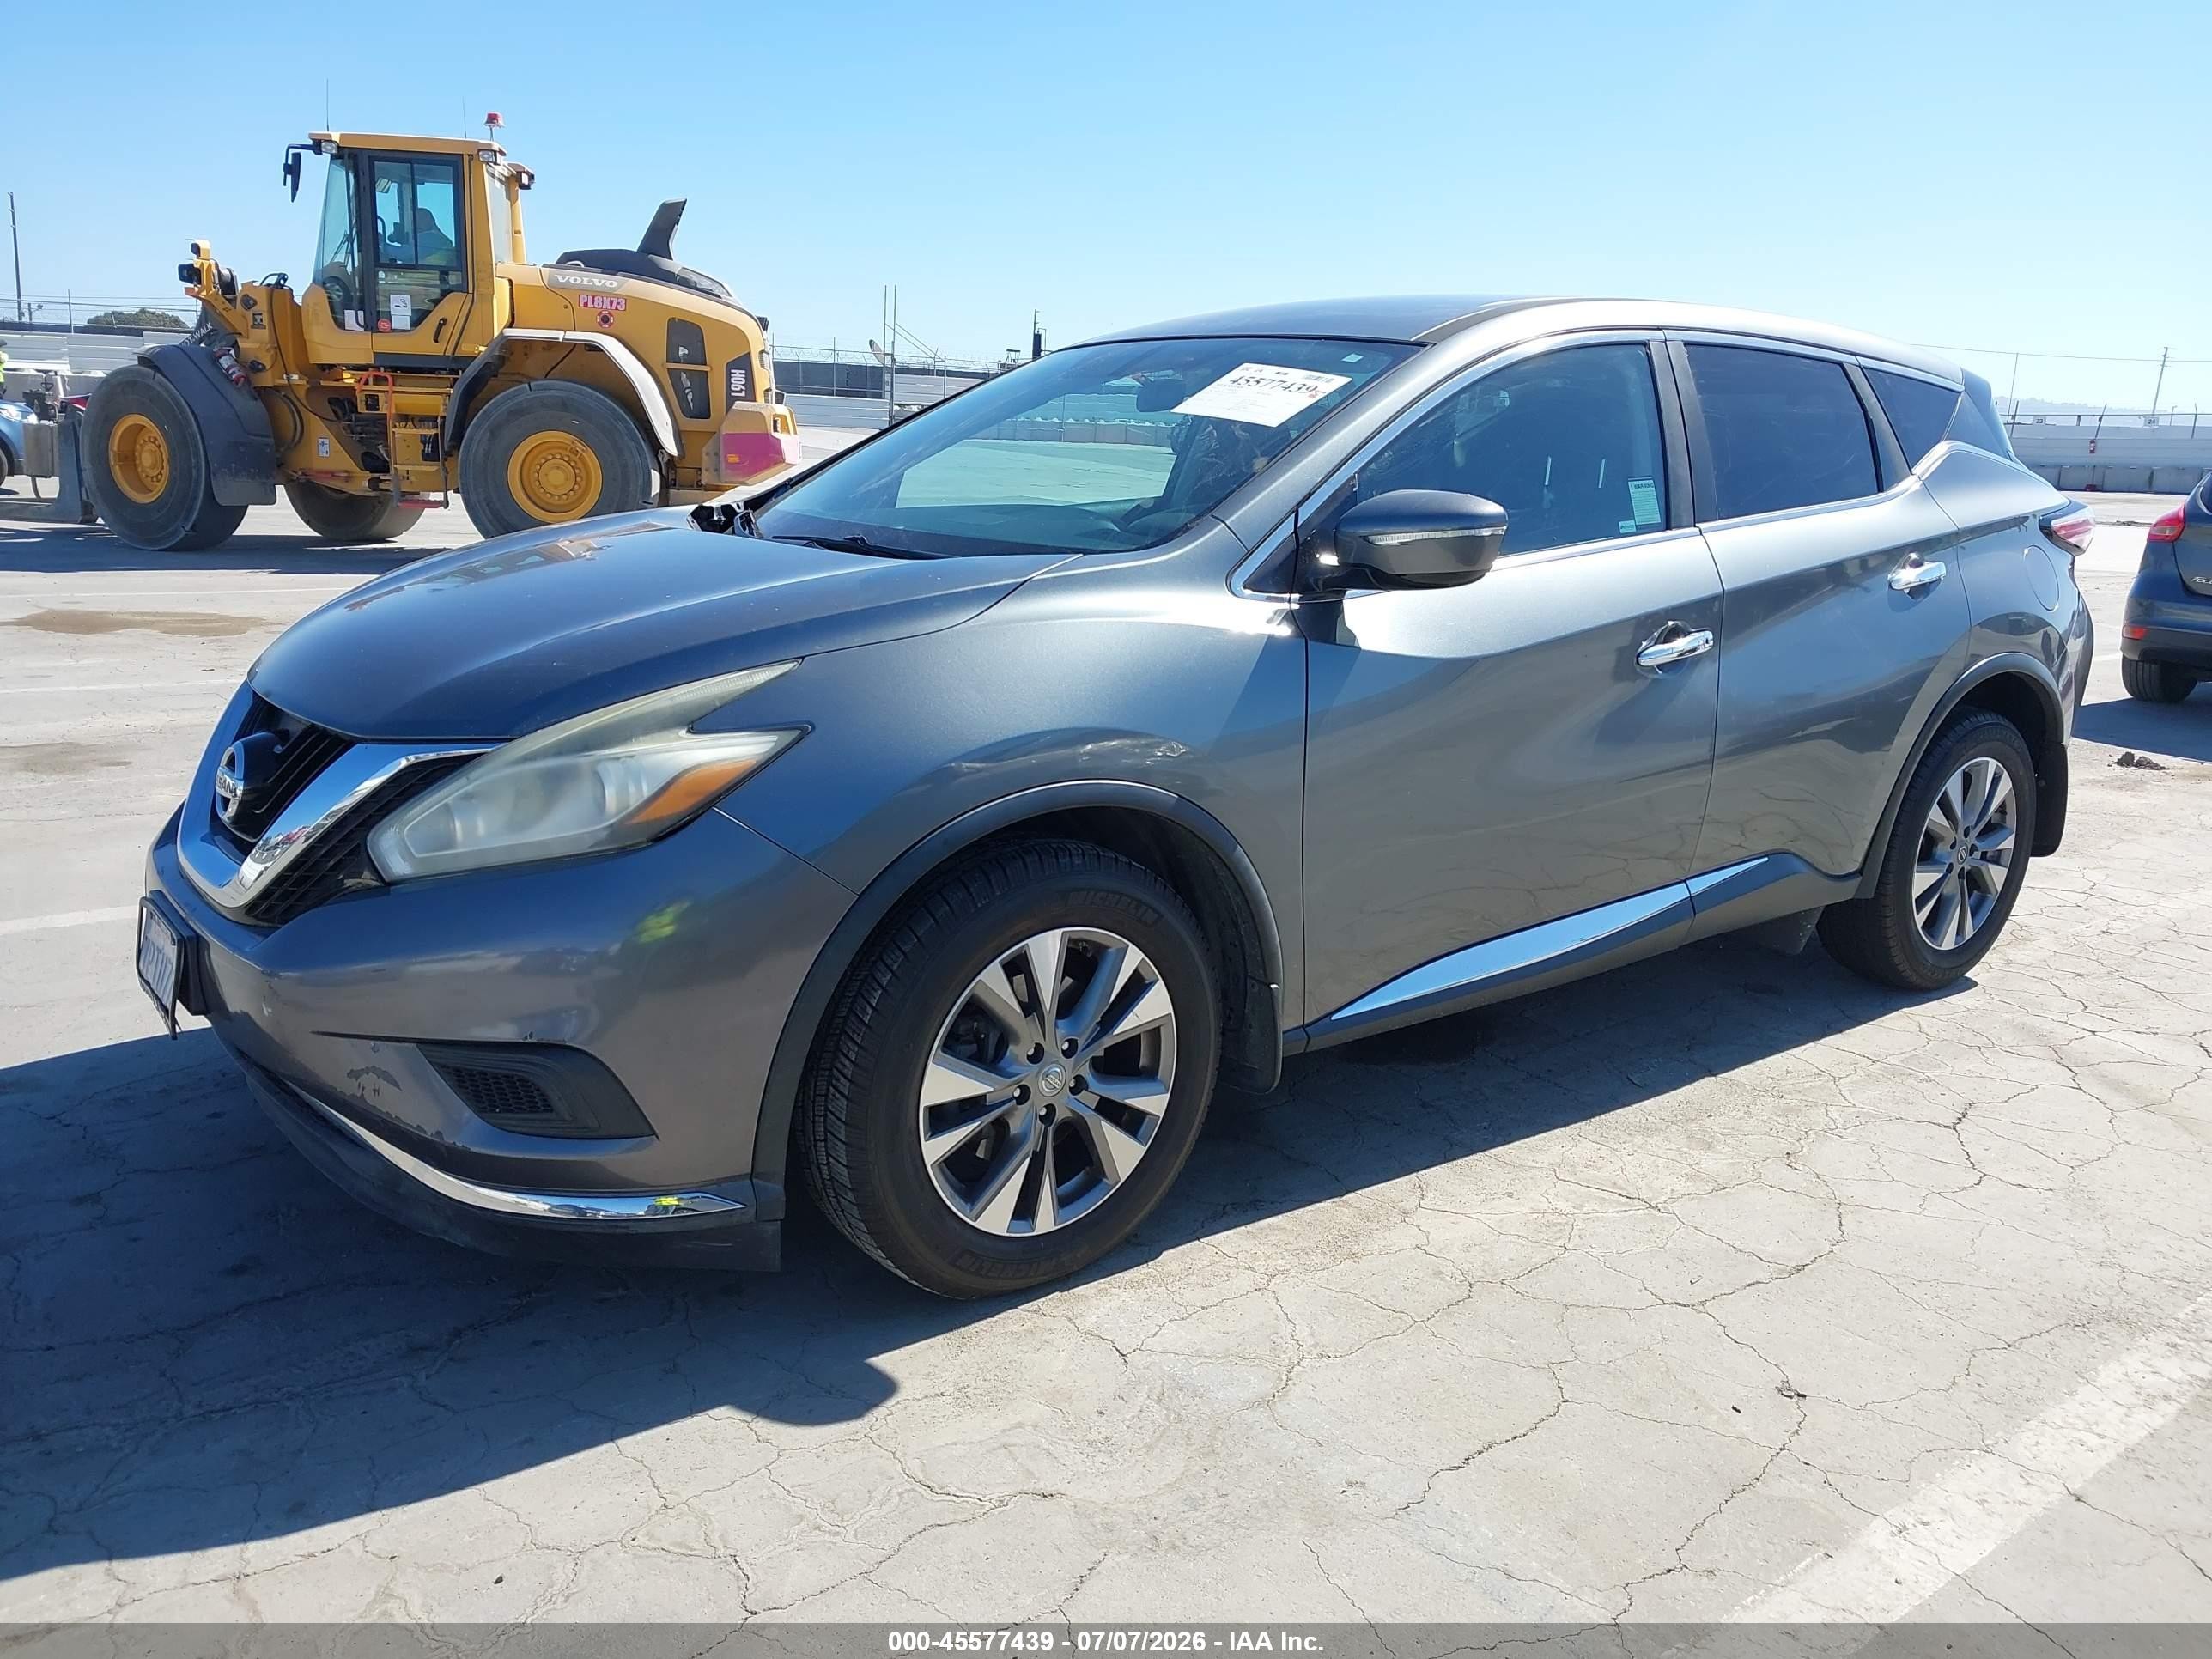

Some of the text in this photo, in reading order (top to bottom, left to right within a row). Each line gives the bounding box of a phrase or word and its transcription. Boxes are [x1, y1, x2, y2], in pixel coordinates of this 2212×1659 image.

[555, 275, 617, 288] VOLVO
[193, 323, 213, 340] WALK
[731, 369, 745, 397] L90H
[1230, 375, 1318, 393] 45577439
